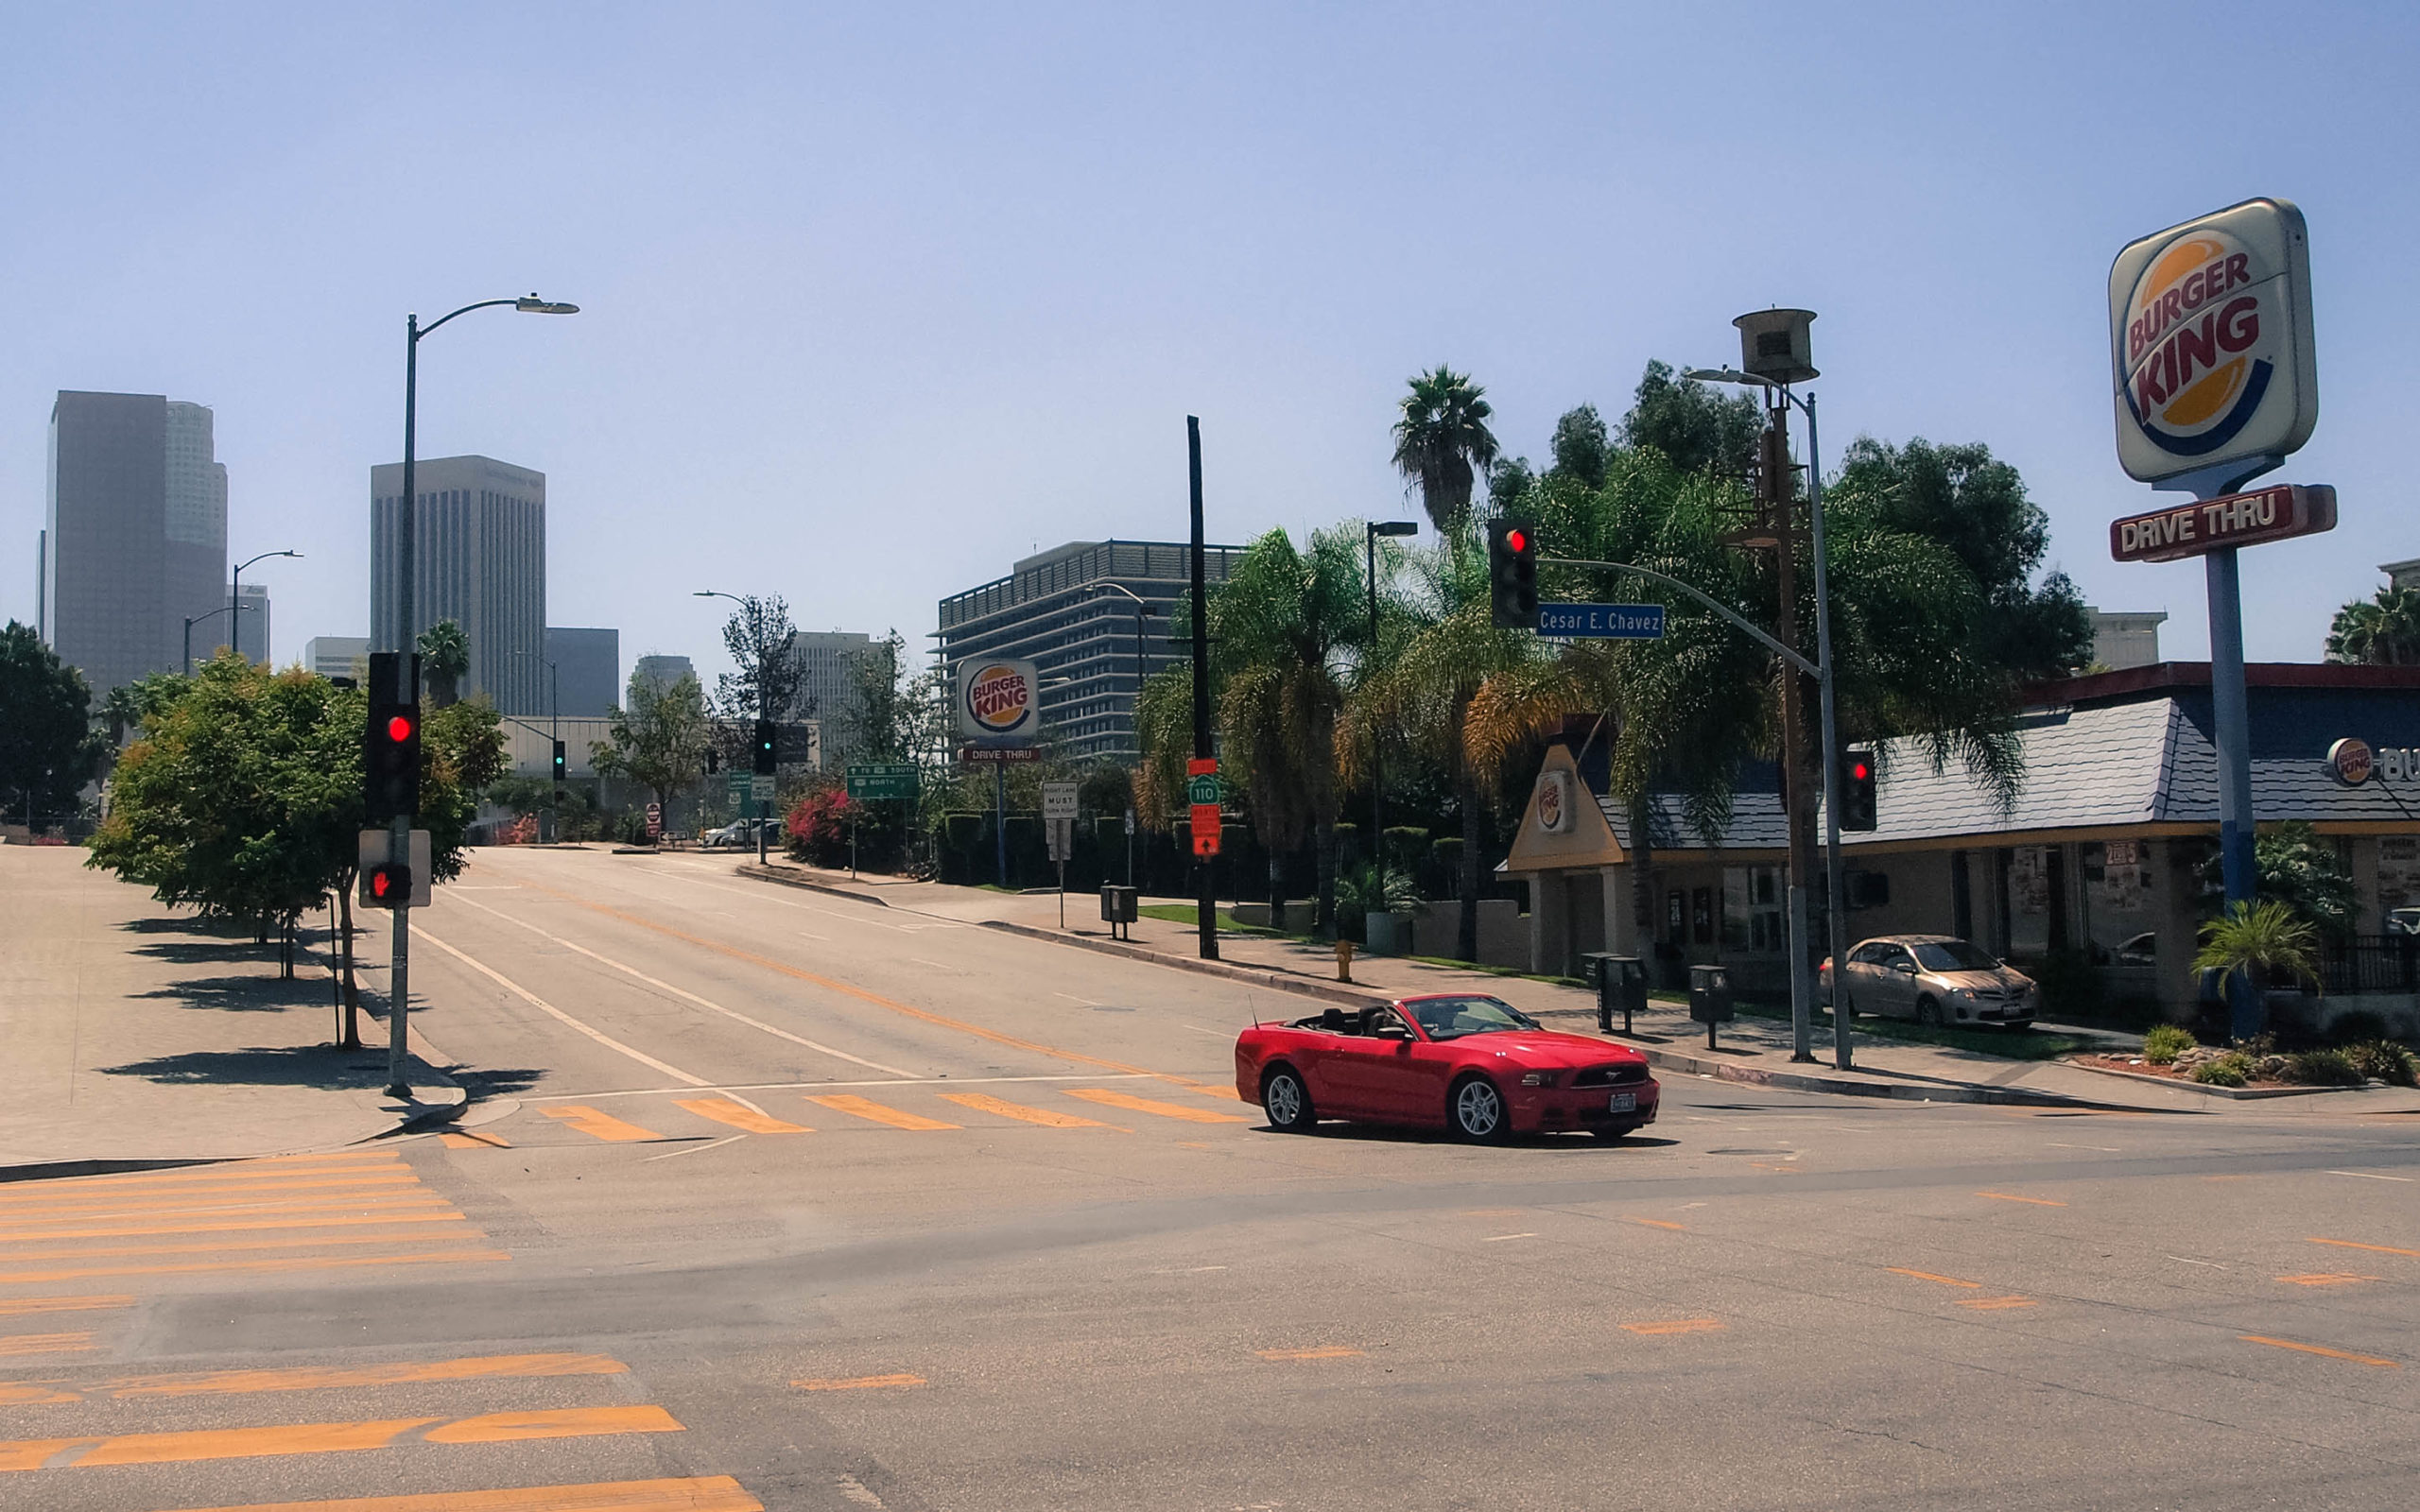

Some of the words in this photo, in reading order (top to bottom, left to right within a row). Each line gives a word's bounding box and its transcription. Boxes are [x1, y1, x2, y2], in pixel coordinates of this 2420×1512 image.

[2130, 253, 2250, 363] BURGER
[2137, 297, 2259, 423] KING
[2121, 508, 2195, 553] DRIVE
[2203, 492, 2275, 536] THRU
[1540, 611, 1582, 628] Cesar
[1590, 612, 1602, 629] E.
[1609, 612, 1659, 630] Chavez
[973, 675, 1026, 701] BURGER
[975, 687, 1028, 718] KING
[973, 749, 1001, 759] DRIVE
[1004, 749, 1031, 759] THRU
[2341, 756, 2371, 774] KING
[1194, 788, 1214, 800] 110
